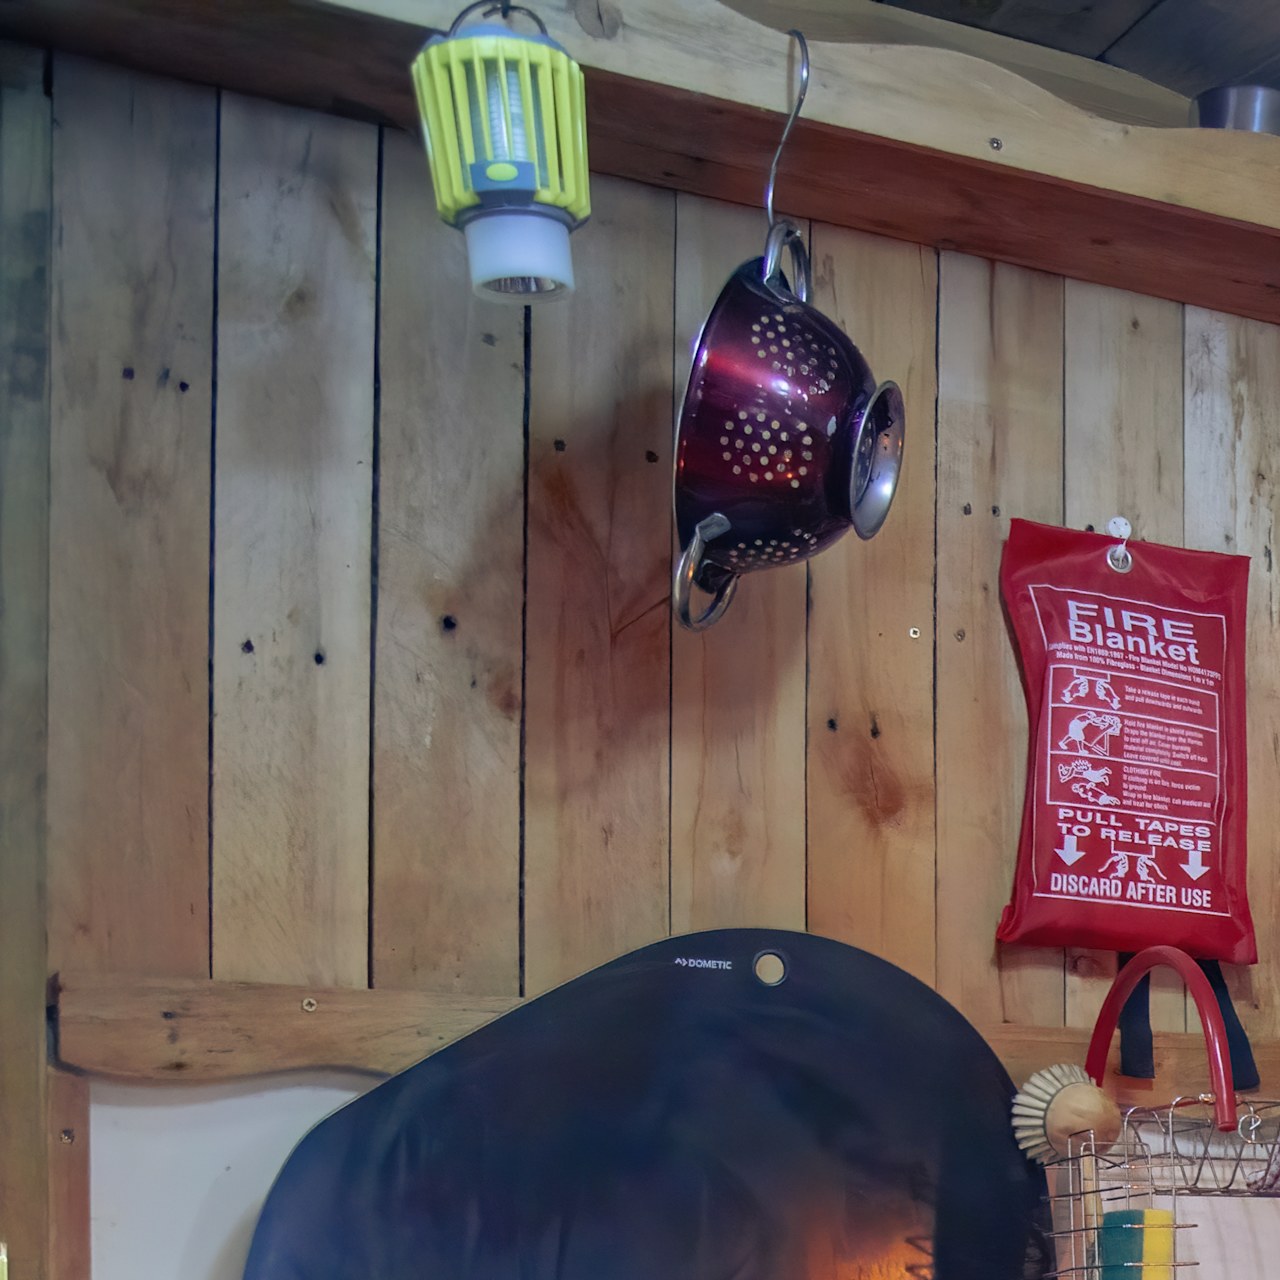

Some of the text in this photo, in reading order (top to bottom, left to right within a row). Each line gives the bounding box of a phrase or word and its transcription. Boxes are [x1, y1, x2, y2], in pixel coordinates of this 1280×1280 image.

[1067, 600, 1197, 644] FIRE
[1068, 619, 1200, 665] Blanket
[1056, 650, 1074, 660] Made
[1074, 653, 1089, 662] from
[1089, 656, 1106, 665] 100%
[1106, 658, 1136, 669] Fibreglass
[1140, 663, 1161, 674] Blanket
[1161, 668, 1192, 681] Dimensions
[1129, 653, 1140, 663] Fire
[1141, 656, 1161, 667] Blanket
[1162, 660, 1179, 670] Model
[1125, 685, 1137, 694] Take
[1141, 689, 1159, 698] release
[1123, 765, 1149, 776] CLOTHING
[1057, 822, 1212, 852] TO RELEASE
[1058, 808, 1211, 838] PULL TAPES
[1051, 872, 1212, 908] DISCARD AFTER USE
[688, 958, 732, 970] DOMETIC
